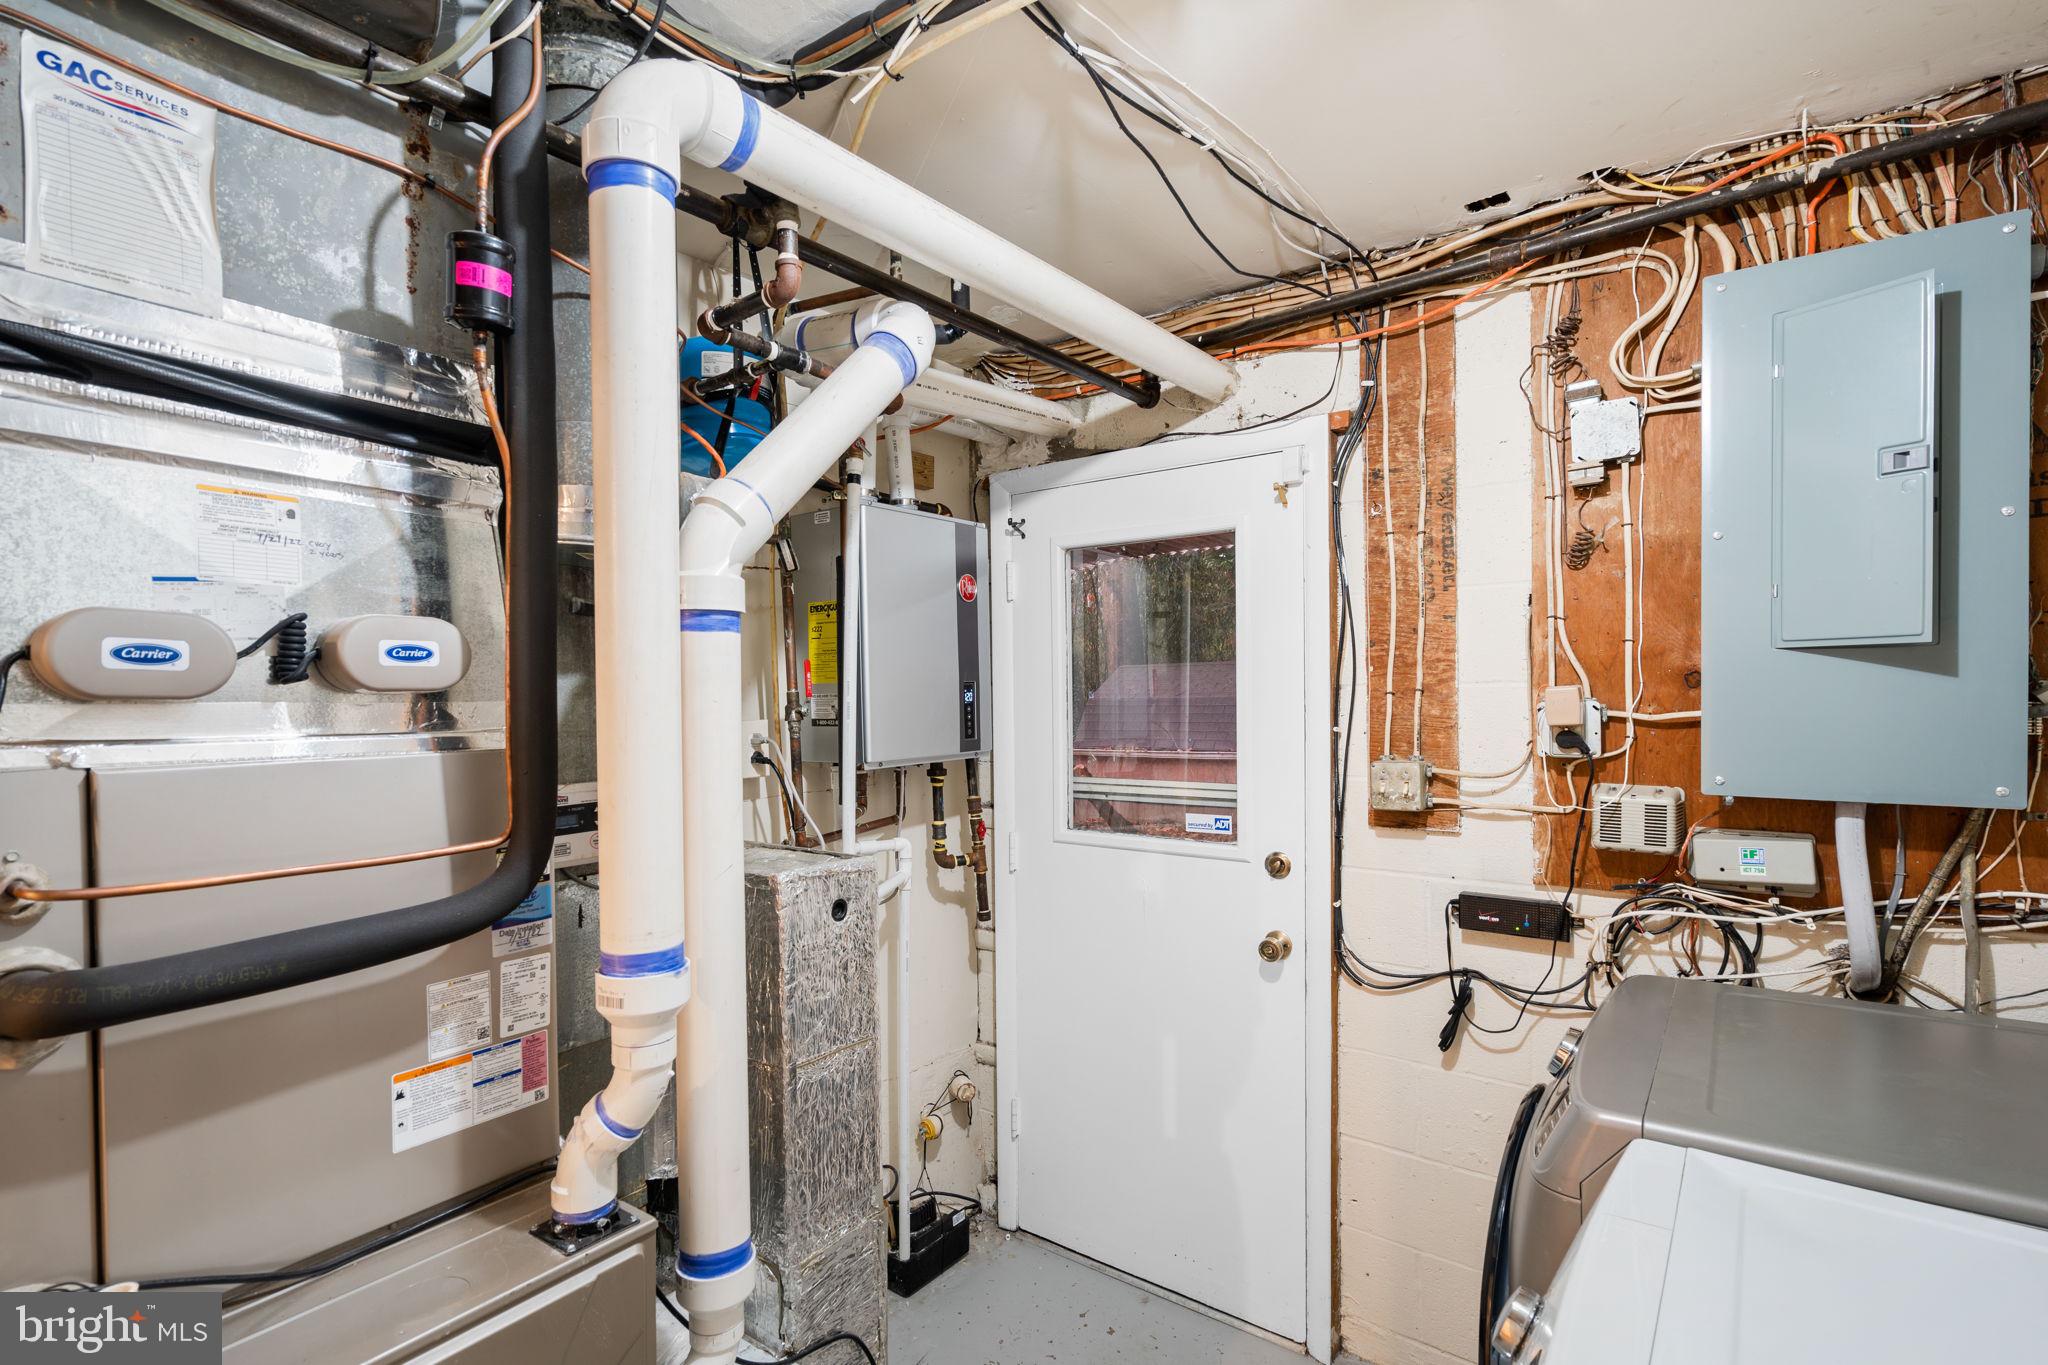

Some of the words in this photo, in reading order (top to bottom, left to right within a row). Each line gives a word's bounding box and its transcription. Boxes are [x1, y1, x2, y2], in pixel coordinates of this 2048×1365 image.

[36, 50, 113, 91] GAC
[115, 81, 189, 117] SERVICES
[121, 647, 174, 660] Carrier
[392, 648, 429, 658] Carrier
[1215, 819, 1231, 829] ADT
